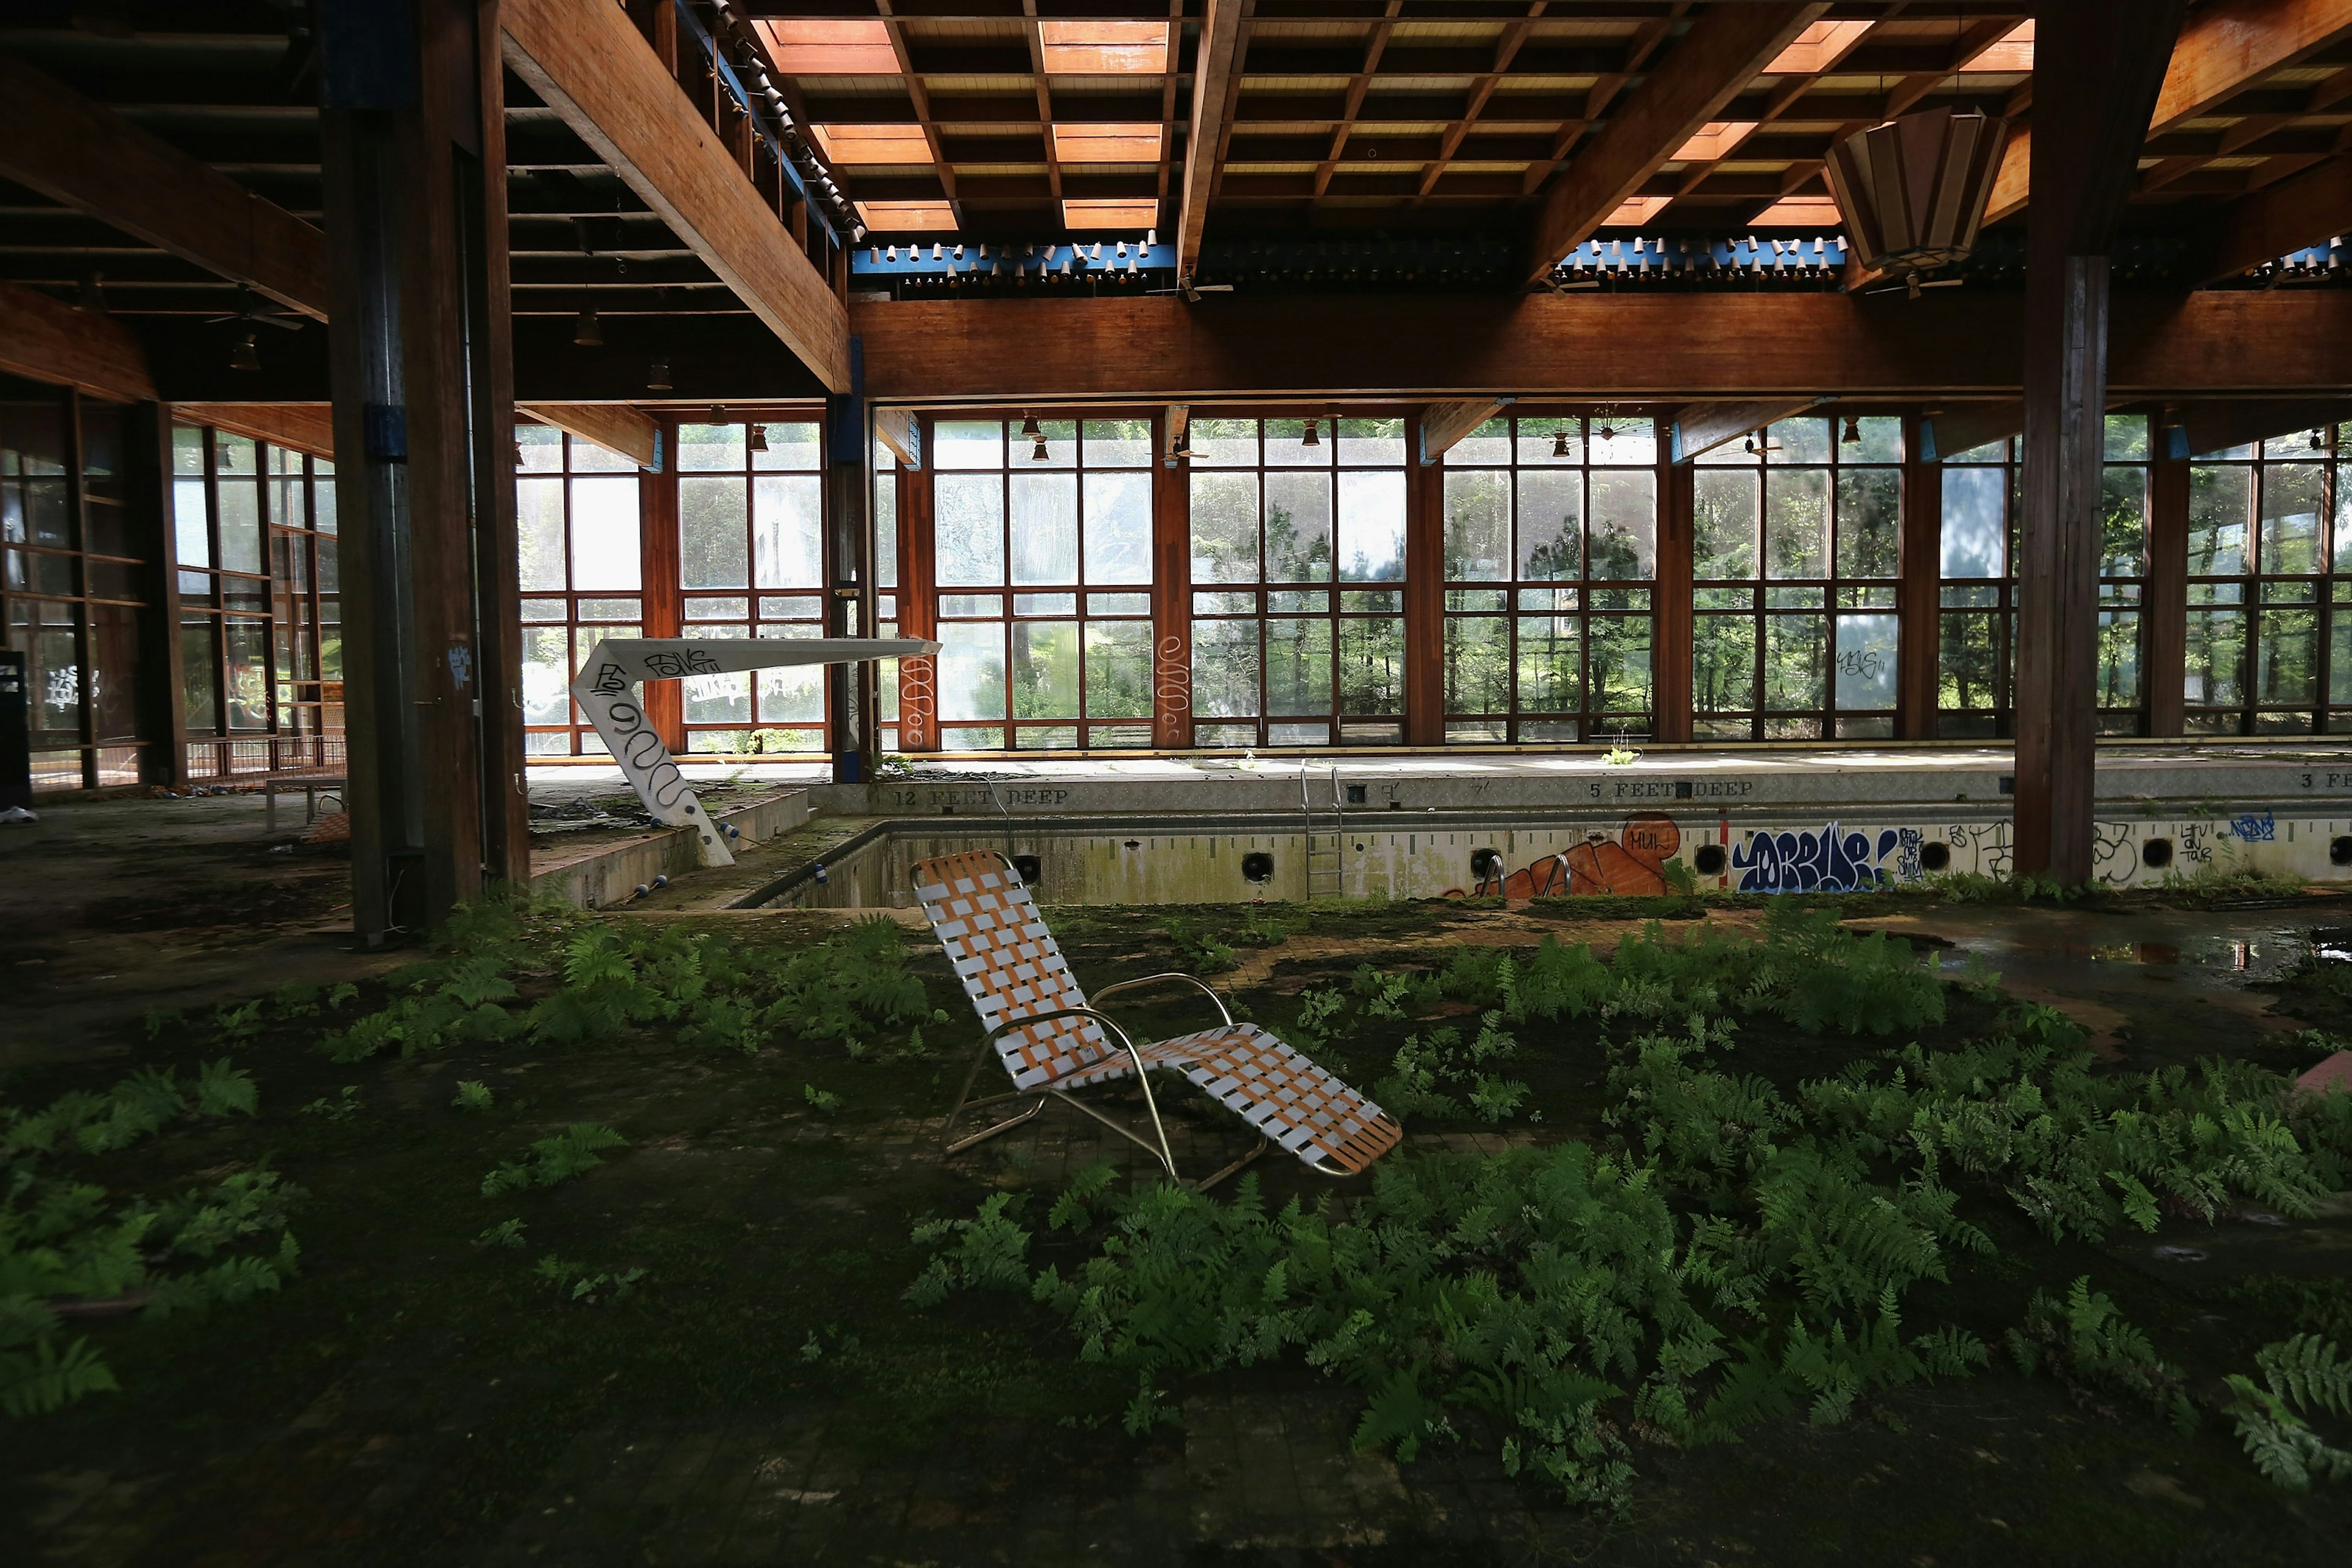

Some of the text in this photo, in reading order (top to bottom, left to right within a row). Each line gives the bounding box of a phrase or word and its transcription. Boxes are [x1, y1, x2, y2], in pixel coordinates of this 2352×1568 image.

[2301, 774, 2312, 788] 3
[1590, 781, 1752, 797] 5 FEET DEEP
[894, 790, 1068, 805] 12 FEET DEEP
